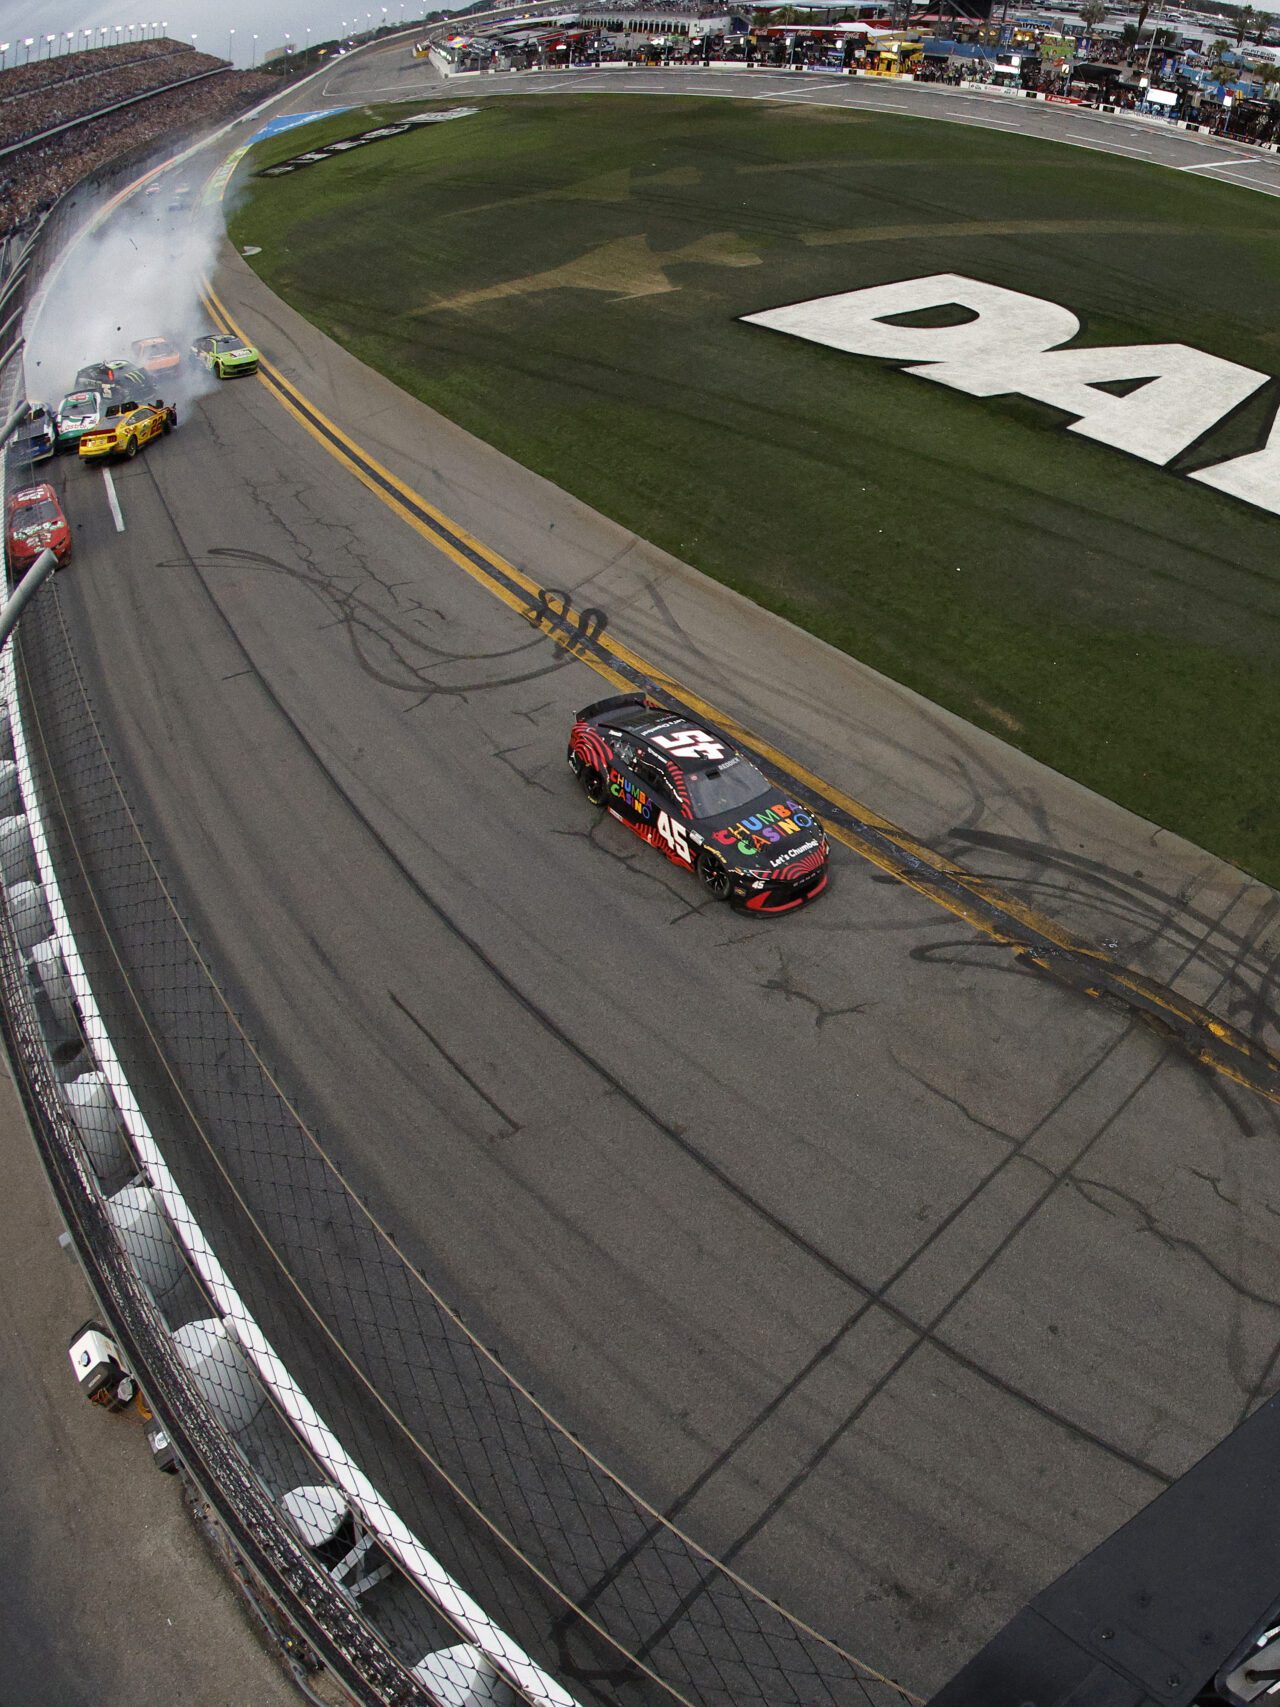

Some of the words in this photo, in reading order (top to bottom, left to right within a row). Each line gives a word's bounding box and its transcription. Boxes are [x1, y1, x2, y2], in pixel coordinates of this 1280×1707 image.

[651, 730, 725, 760] 45
[610, 768, 652, 811] CHUMBA
[610, 783, 650, 819] CASINO
[657, 810, 692, 864] 45
[712, 800, 802, 845] CHUMBA
[737, 813, 812, 855] CASINO
[770, 854, 790, 868] Let's
[788, 838, 819, 858] Chumba!
[751, 880, 765, 889] 45
